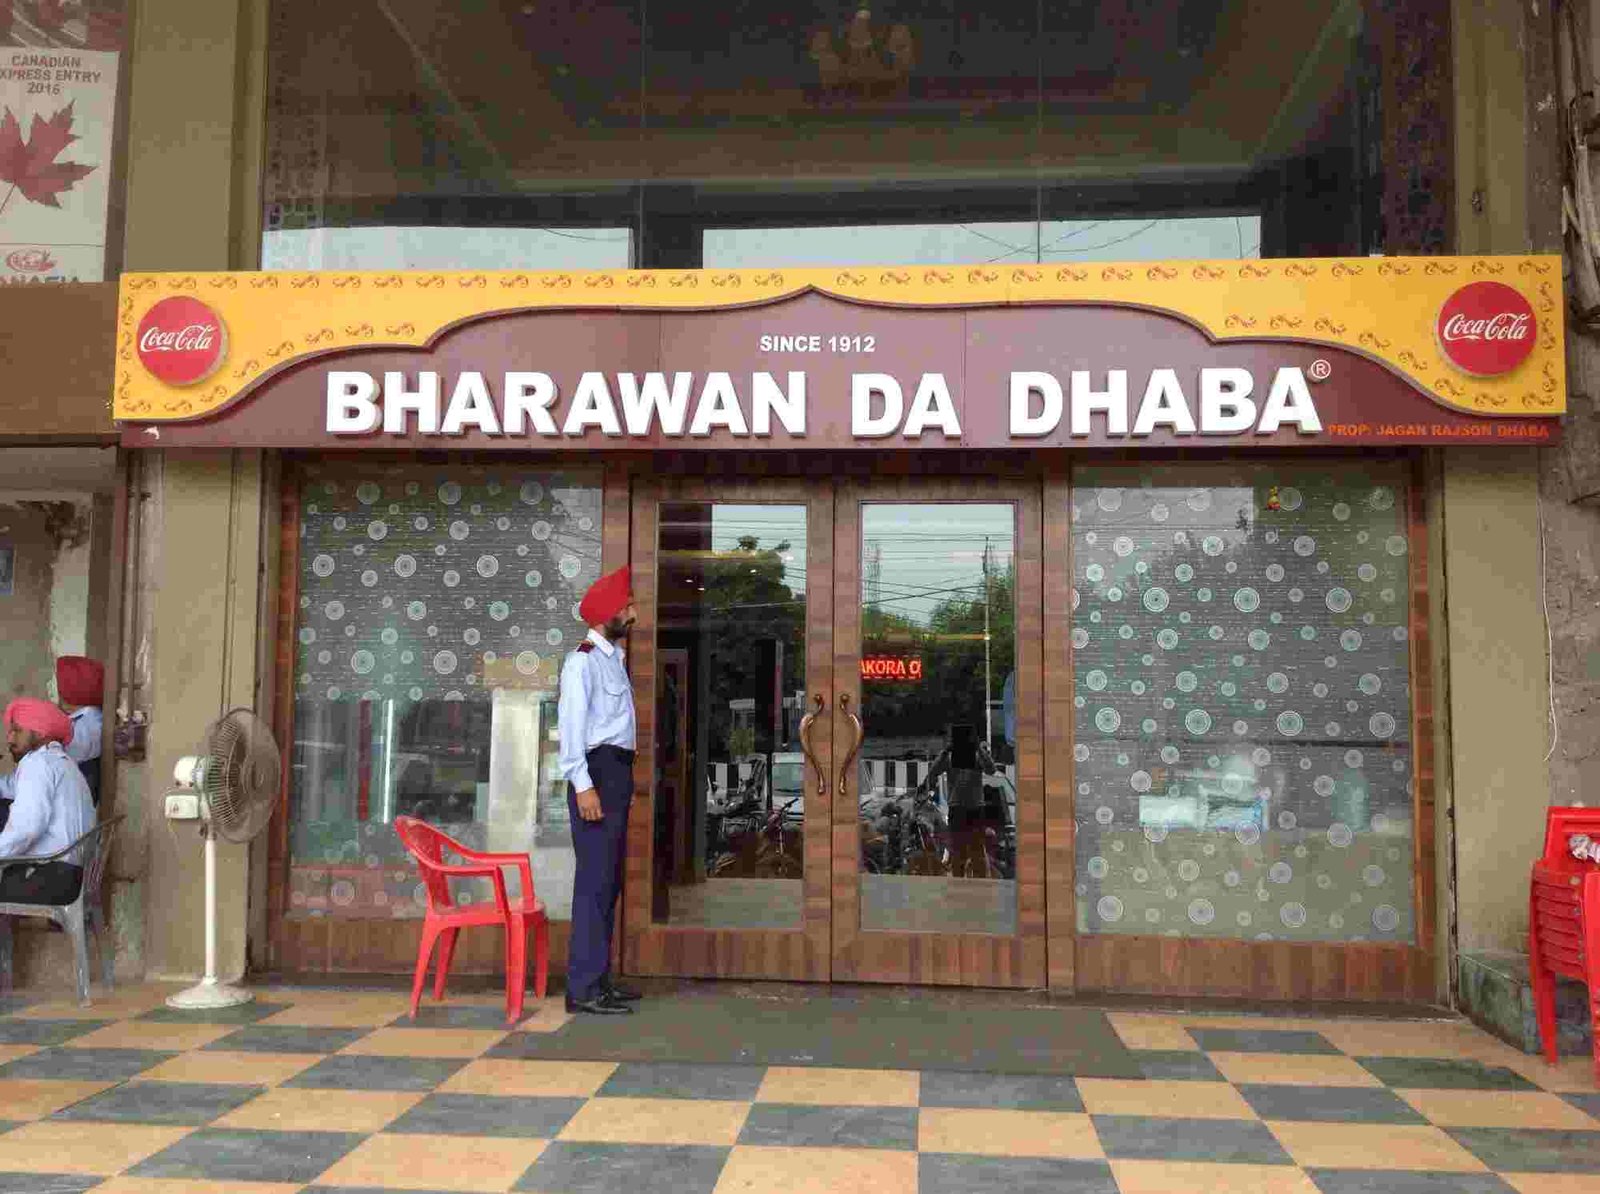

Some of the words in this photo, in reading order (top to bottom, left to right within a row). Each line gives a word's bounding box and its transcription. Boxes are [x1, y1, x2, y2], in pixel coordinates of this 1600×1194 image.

[12, 55, 81, 68] CANADIAN
[56, 70, 101, 83] ENTRY
[27, 82, 61, 95] 2016
[759, 335, 821, 352] SINCE
[828, 335, 876, 352] 1912
[326, 371, 807, 437] BHARAWAN
[851, 372, 962, 438] DA
[1009, 366, 1324, 436] DHABA
[1376, 424, 1427, 437] JAGAN
[1497, 424, 1550, 438] DHABA
